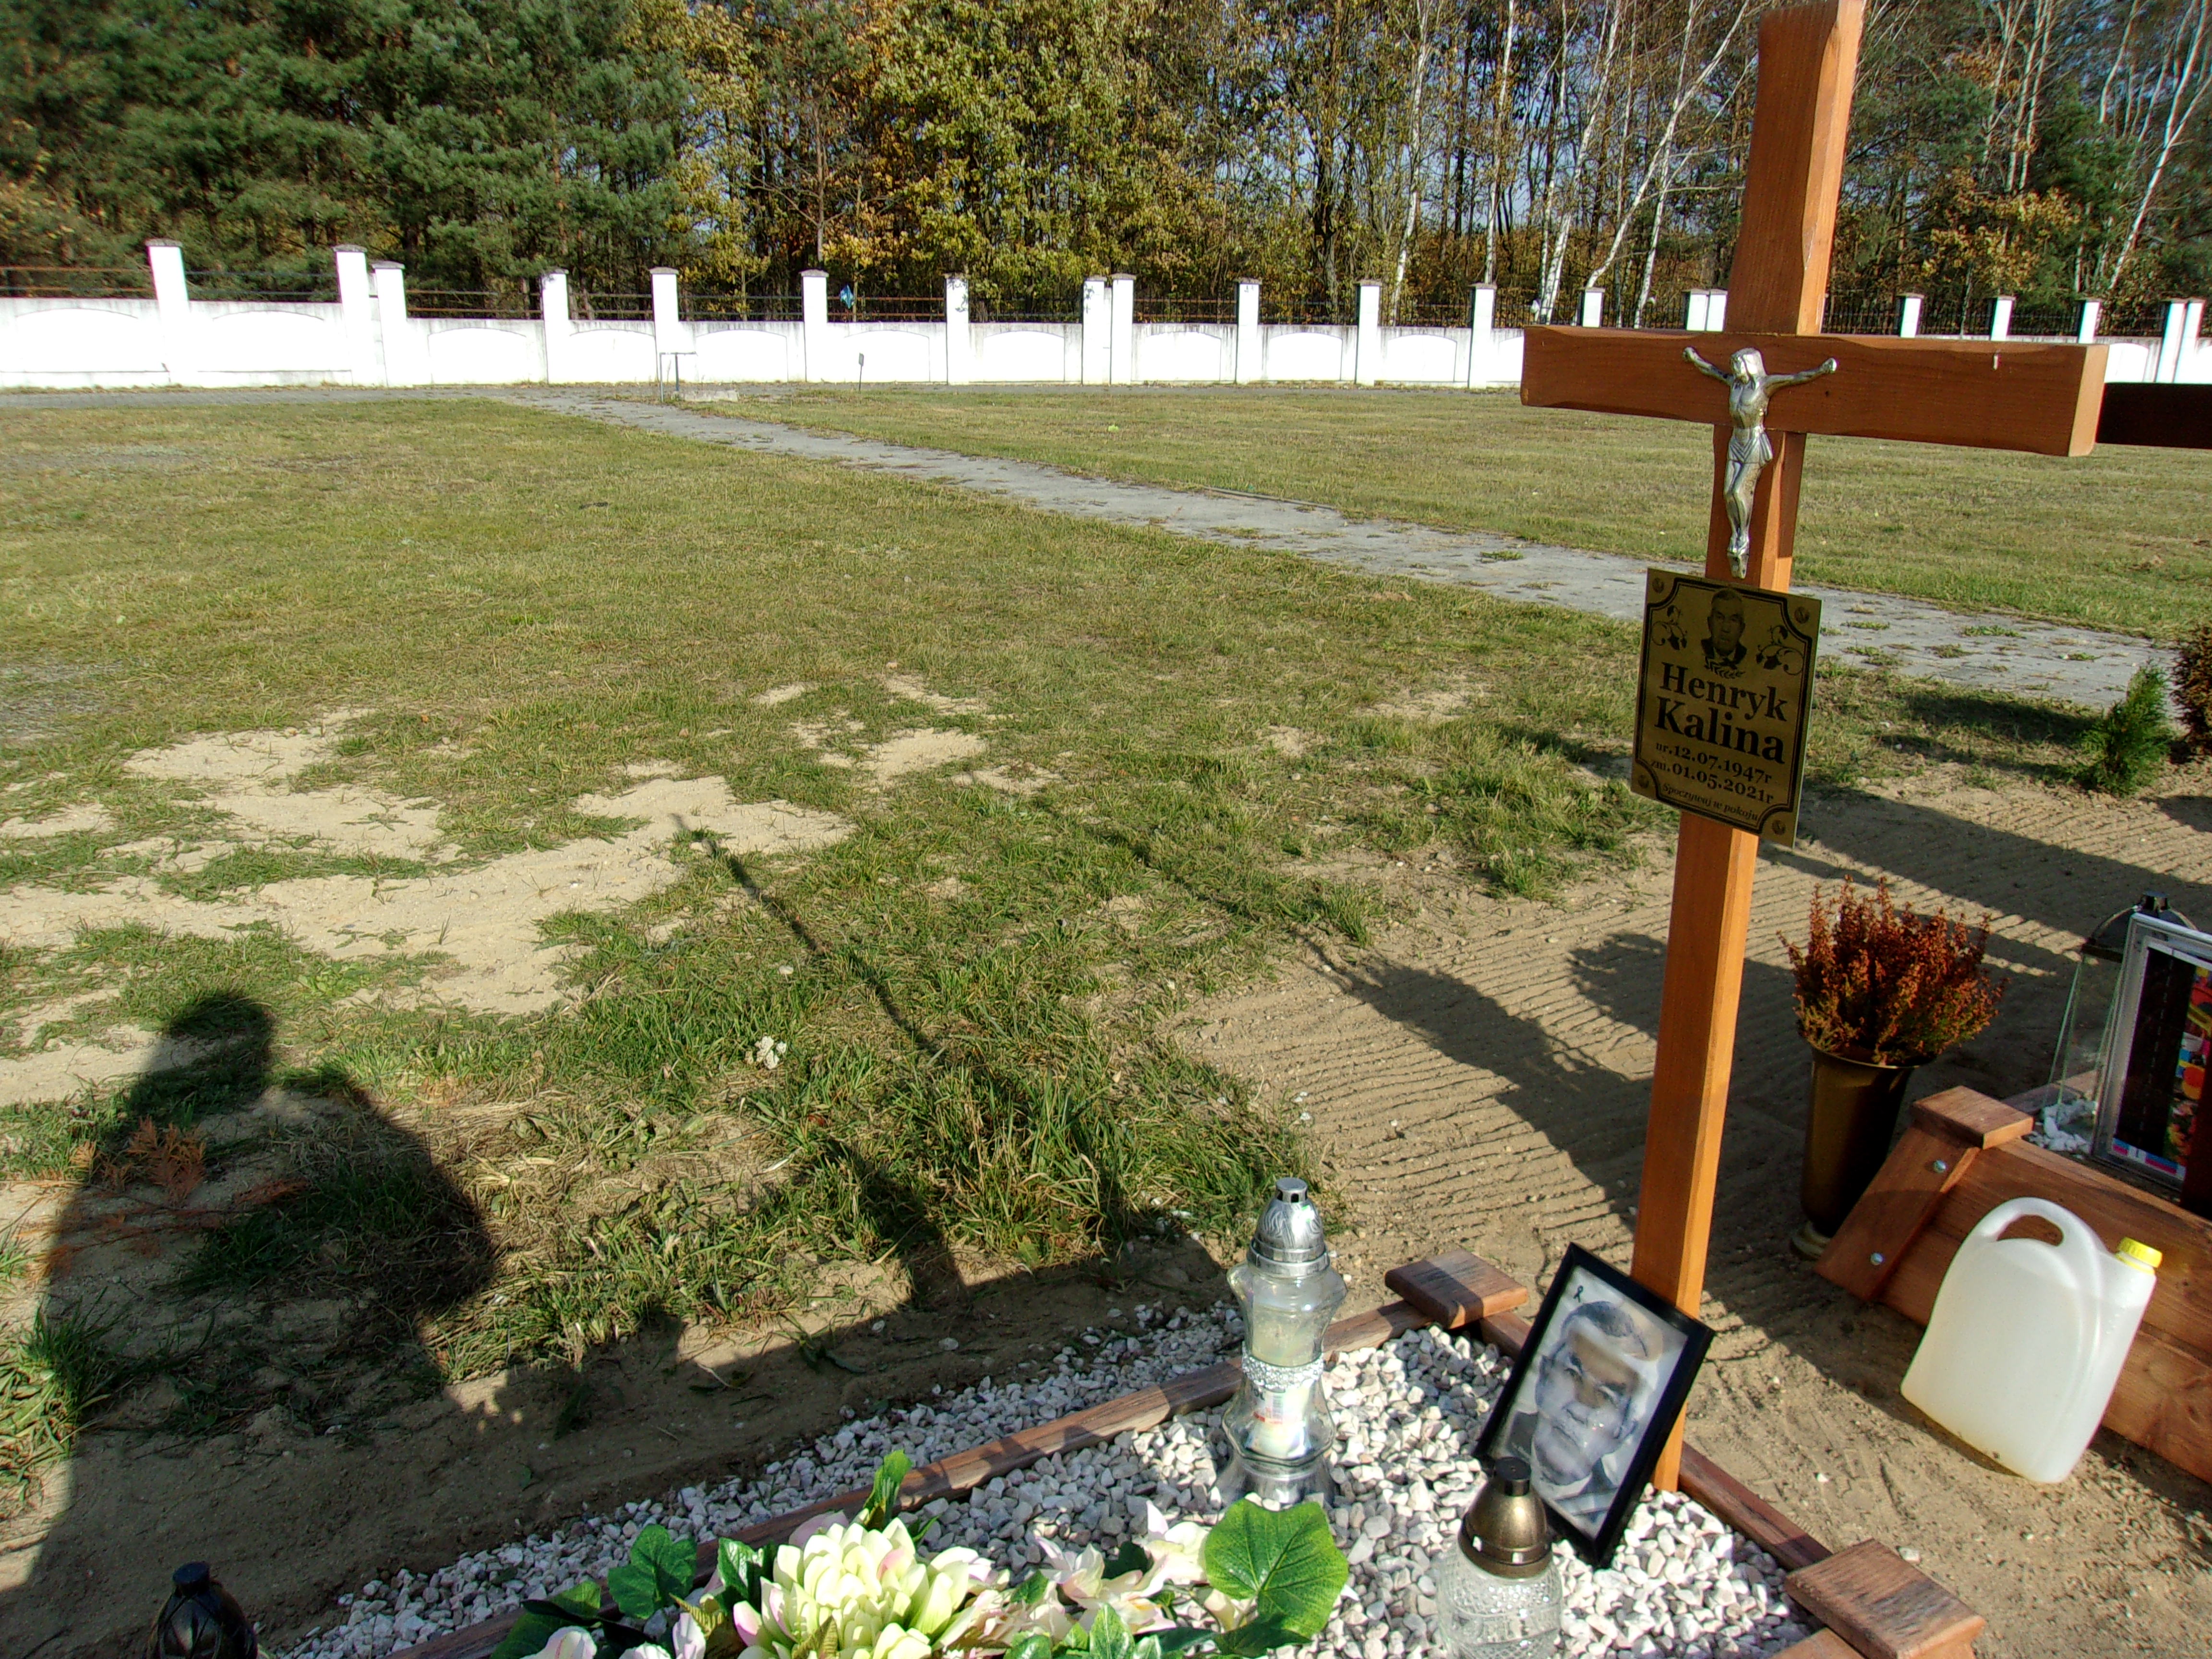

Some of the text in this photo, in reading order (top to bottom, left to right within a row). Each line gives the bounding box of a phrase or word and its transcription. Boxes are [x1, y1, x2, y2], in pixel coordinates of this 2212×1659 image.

[1659, 661, 1788, 722] Henryk
[1654, 696, 1785, 764] Kalina
[1656, 743, 1772, 784] ur.12.07.1947r
[1663, 783, 1759, 821] Spoczywaj w pokoju
